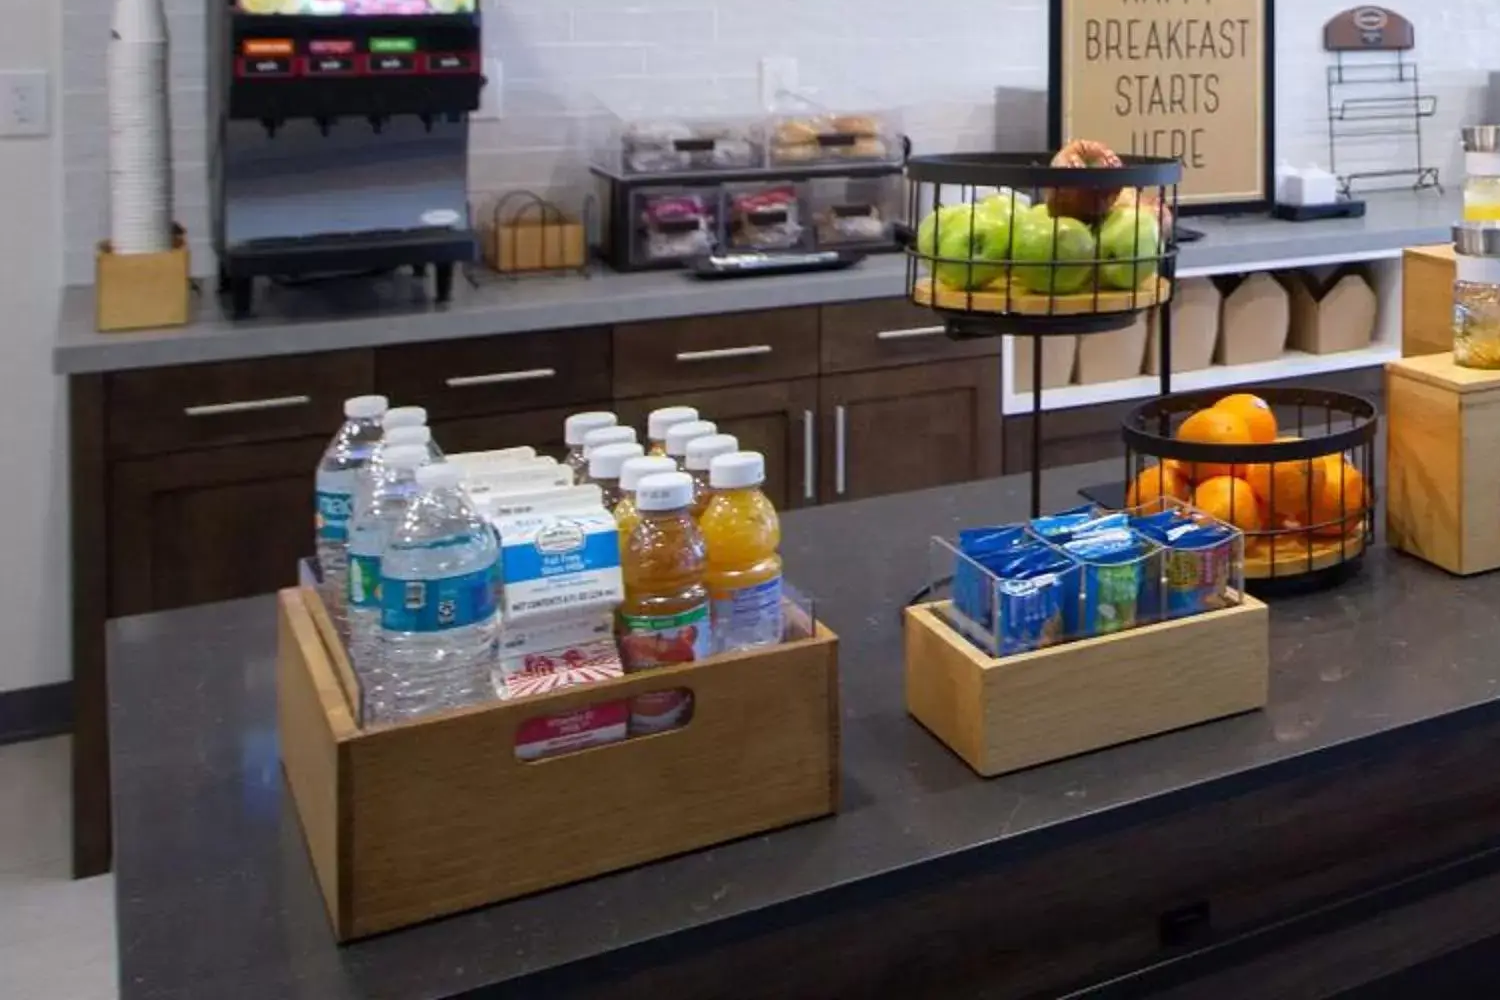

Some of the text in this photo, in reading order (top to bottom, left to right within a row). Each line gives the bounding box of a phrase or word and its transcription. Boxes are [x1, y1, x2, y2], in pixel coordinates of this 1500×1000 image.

[1085, 17, 1250, 62] BREAKFAST
[1115, 73, 1220, 117] STARTS
[1131, 127, 1206, 169] HERE
